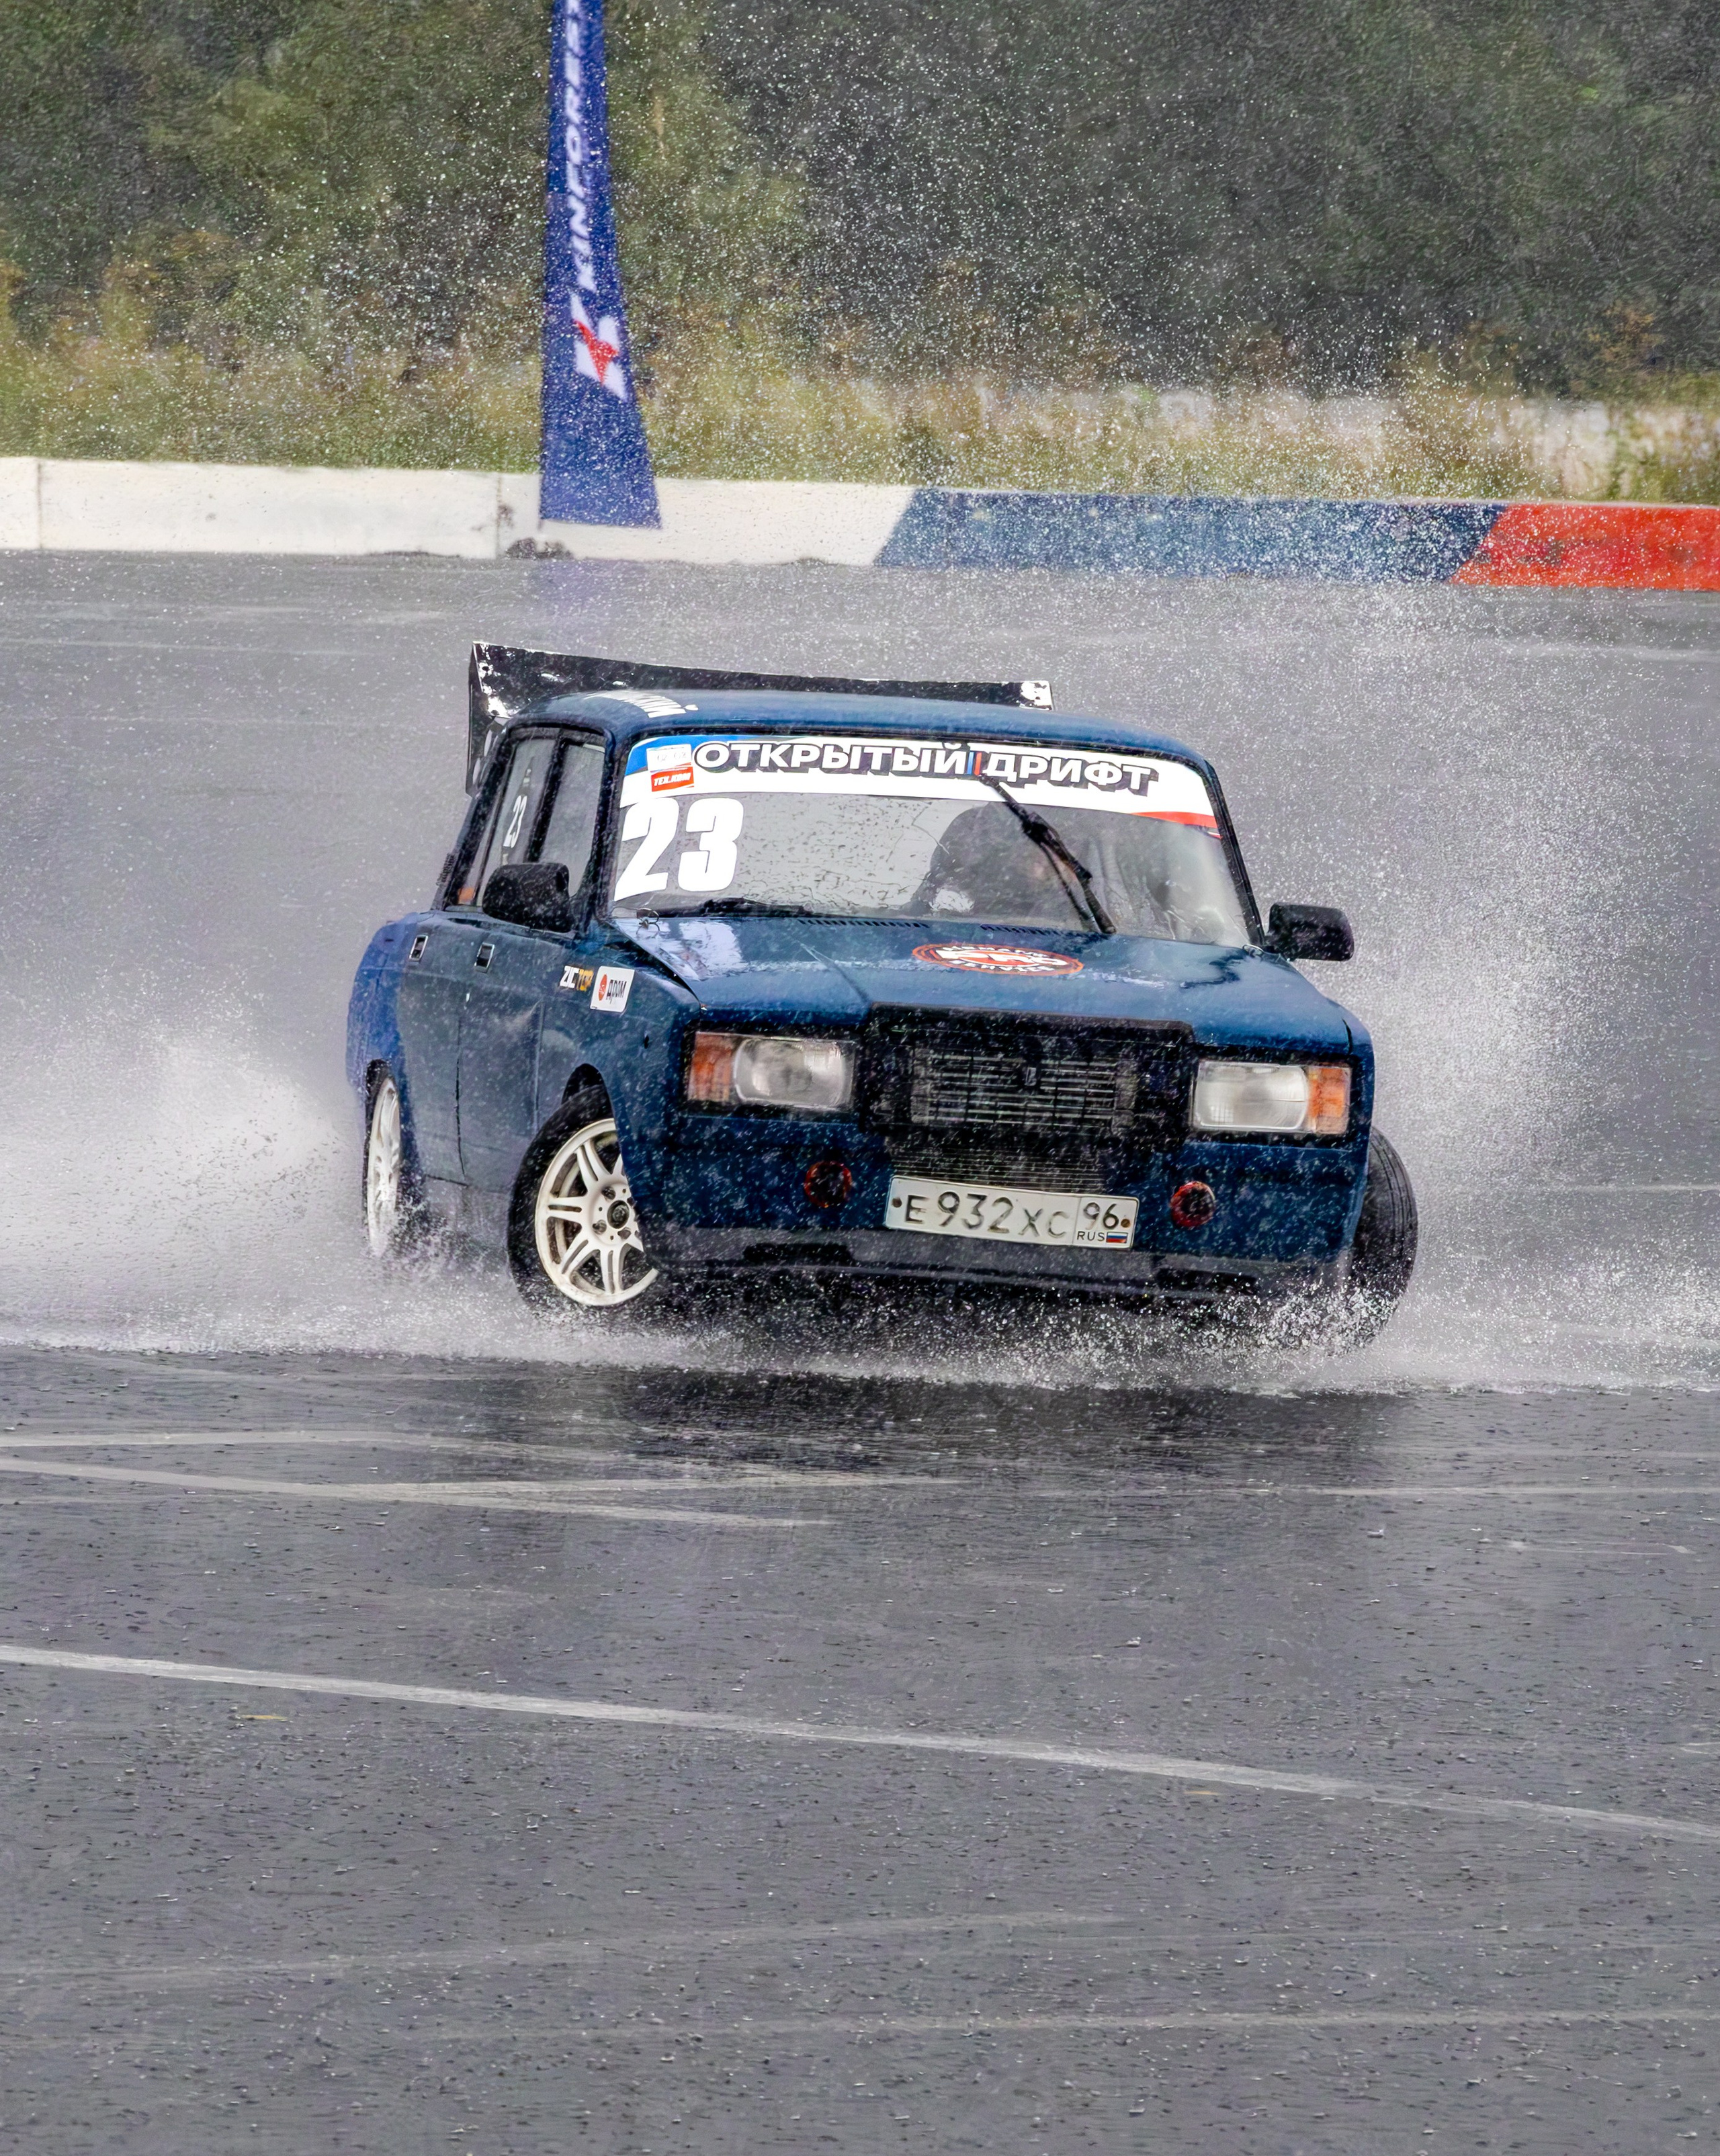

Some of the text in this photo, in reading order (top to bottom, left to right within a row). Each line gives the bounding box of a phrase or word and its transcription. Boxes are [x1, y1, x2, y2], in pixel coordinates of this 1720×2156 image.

[695, 740, 1154, 794] ОТКРЫТЫЙ ДРИФТ
[504, 795, 527, 848] 23
[613, 797, 744, 901] 23
[1077, 1231, 1105, 1242] RUS
[1083, 1202, 1119, 1230] 96
